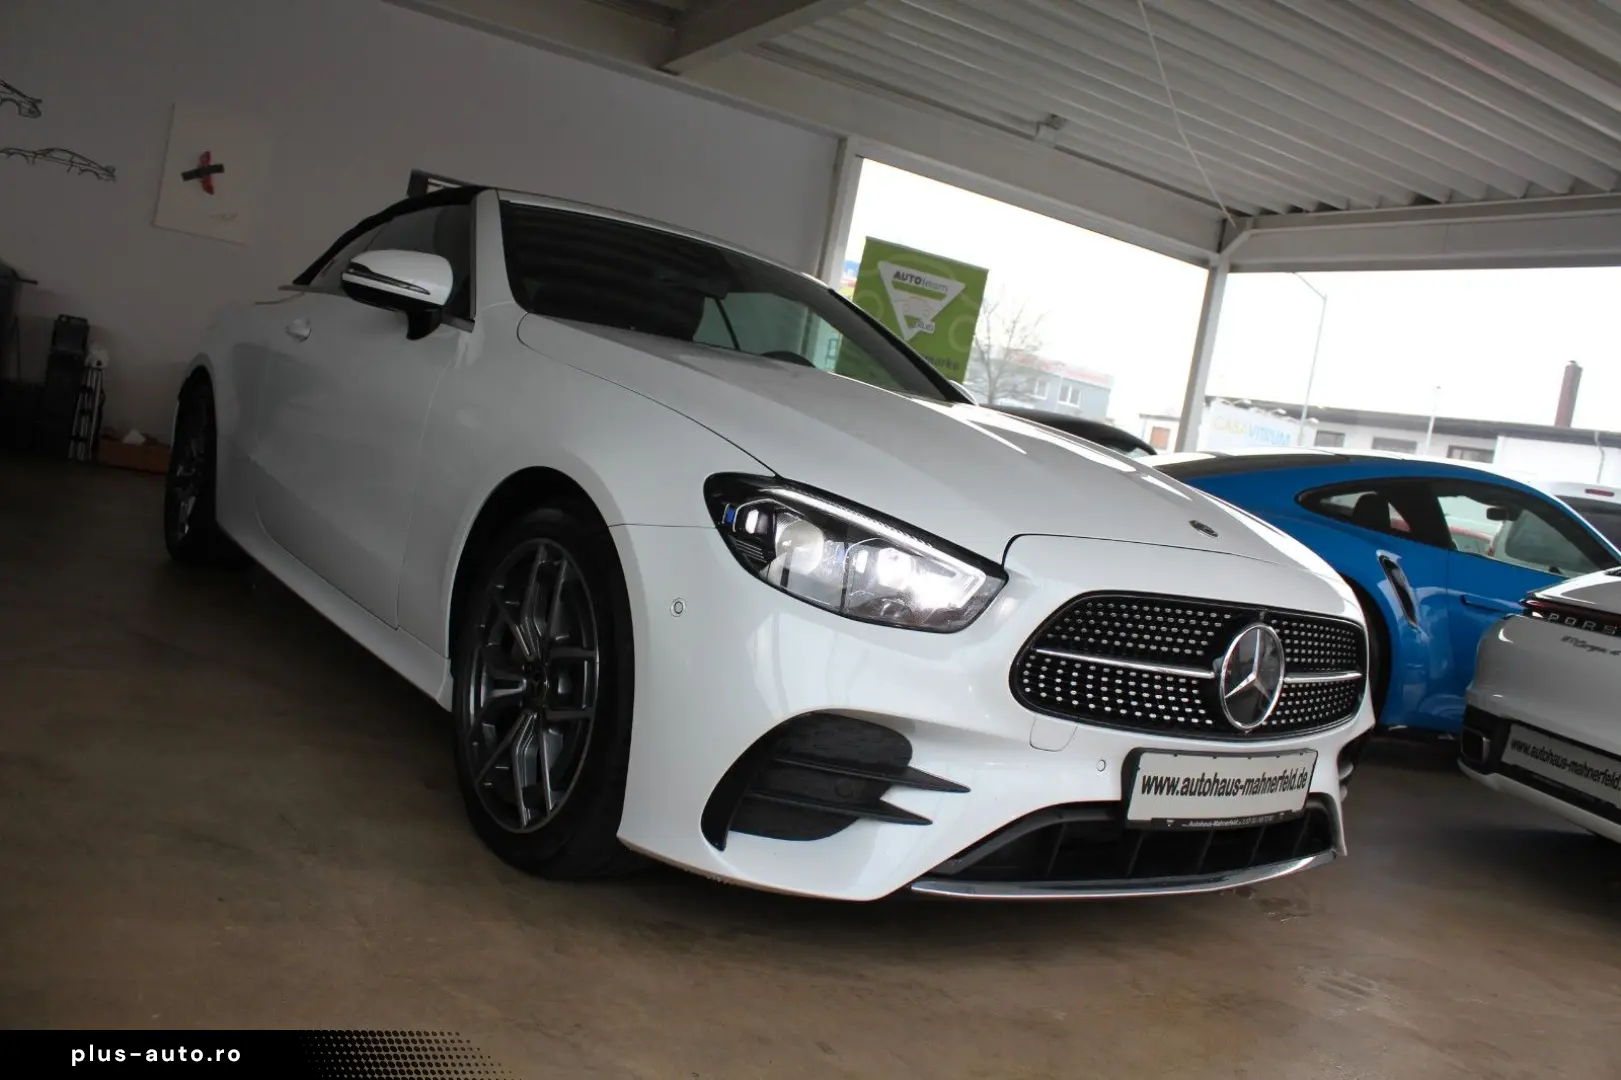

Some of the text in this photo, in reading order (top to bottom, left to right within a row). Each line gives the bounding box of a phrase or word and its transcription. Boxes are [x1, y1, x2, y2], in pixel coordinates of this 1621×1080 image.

[893, 270, 948, 292] AUTOteam
[1511, 738, 1621, 791] www.autohaus-mahnerfeld.
[1141, 767, 1308, 797] www.autohaus-mahnerfeld.de
